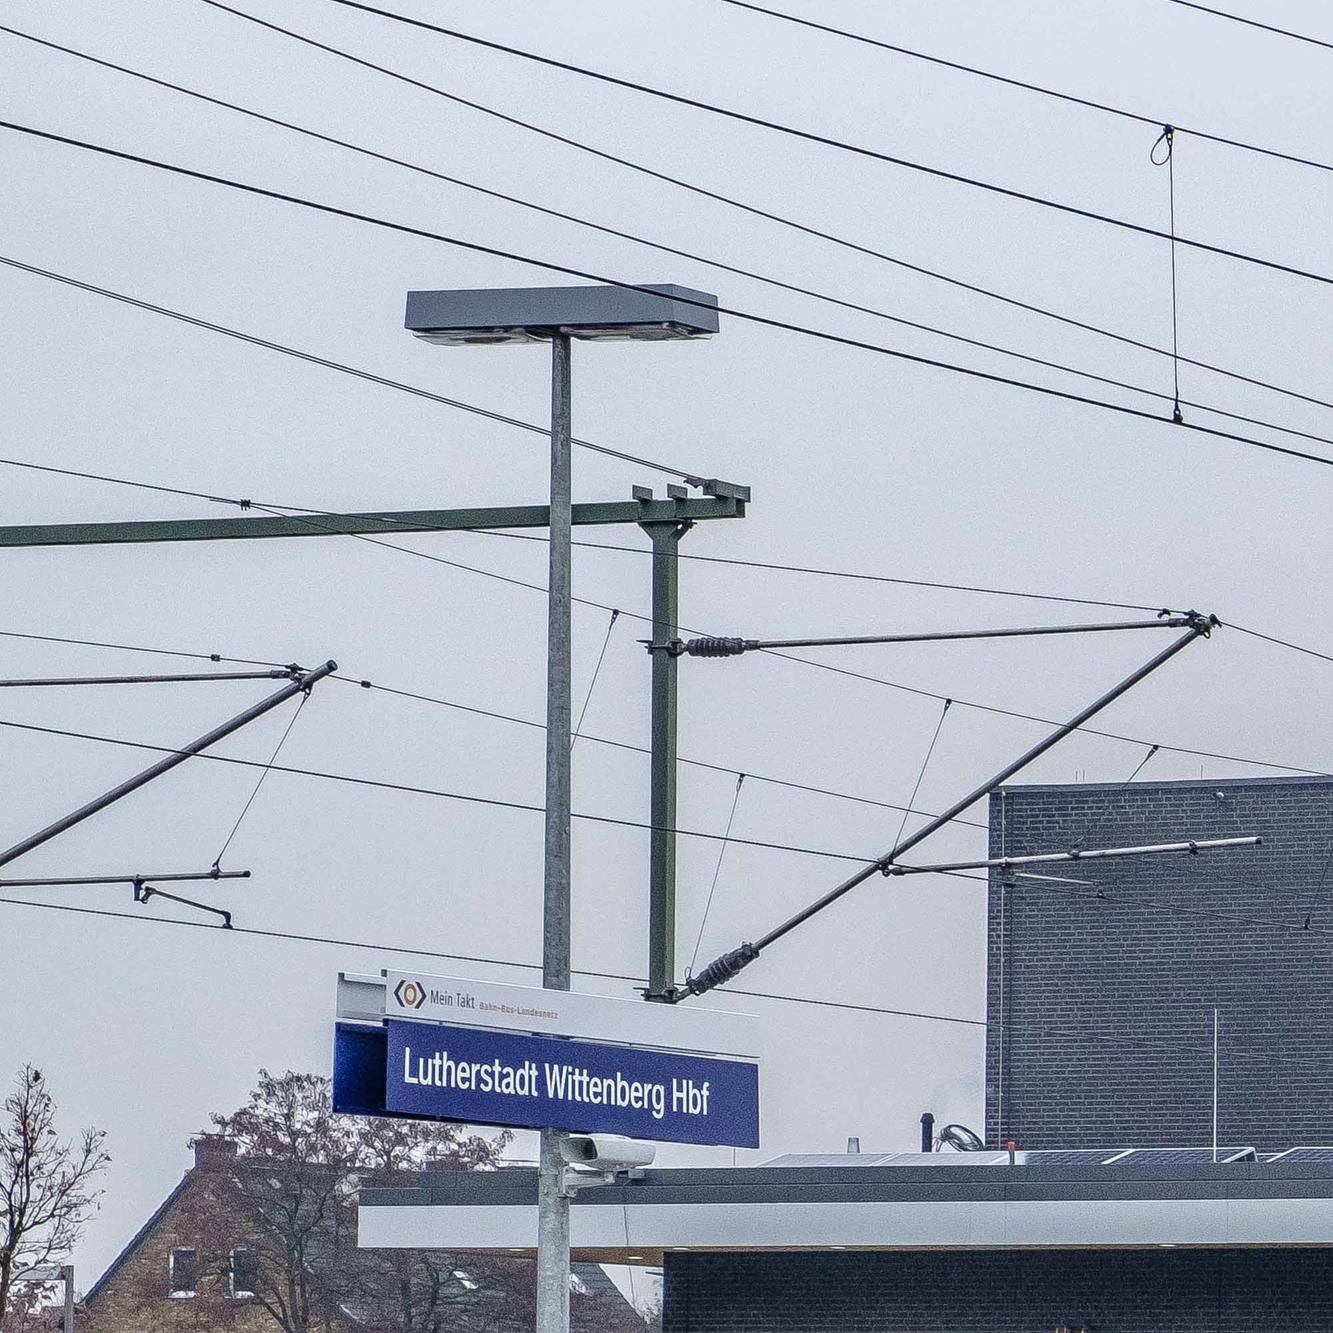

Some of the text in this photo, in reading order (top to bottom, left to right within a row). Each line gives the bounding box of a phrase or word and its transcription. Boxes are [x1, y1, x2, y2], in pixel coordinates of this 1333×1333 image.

[430, 989, 454, 1007] Mein
[455, 992, 476, 1009] Takt
[404, 1046, 711, 1119] Lutherstadt Wittenberg Hbf
